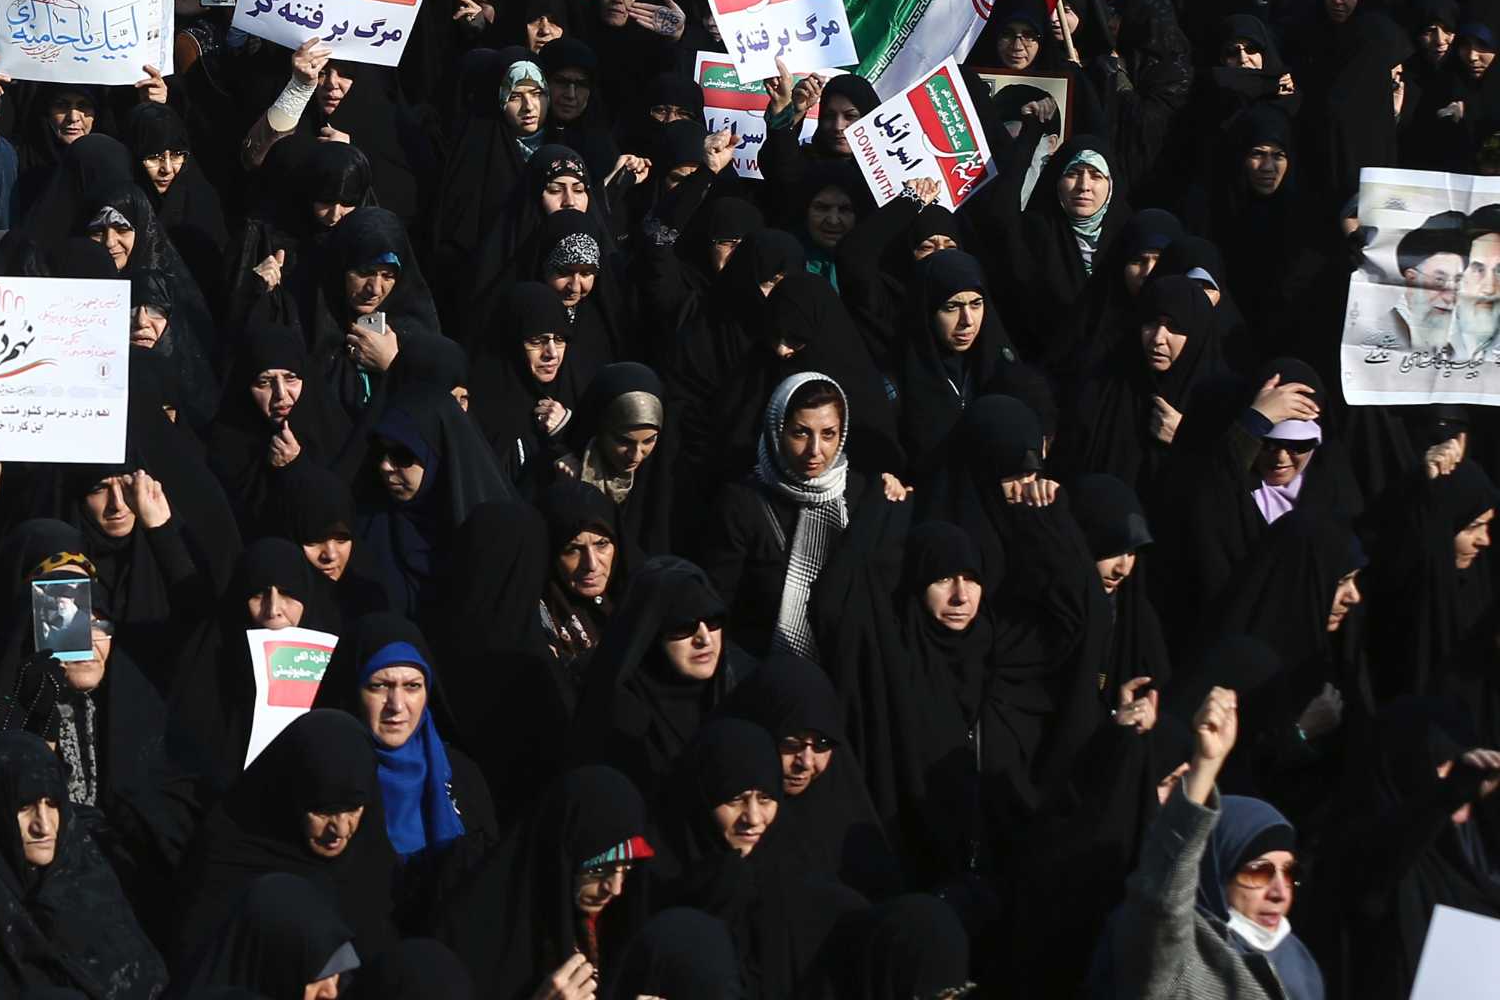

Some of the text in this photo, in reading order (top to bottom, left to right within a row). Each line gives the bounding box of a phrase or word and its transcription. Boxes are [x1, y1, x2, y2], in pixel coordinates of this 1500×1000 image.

[322, 20, 349, 42] بر
[354, 19, 403, 47] مرگ
[796, 13, 840, 47] مرگ
[853, 126, 895, 199] DOWN WITH
